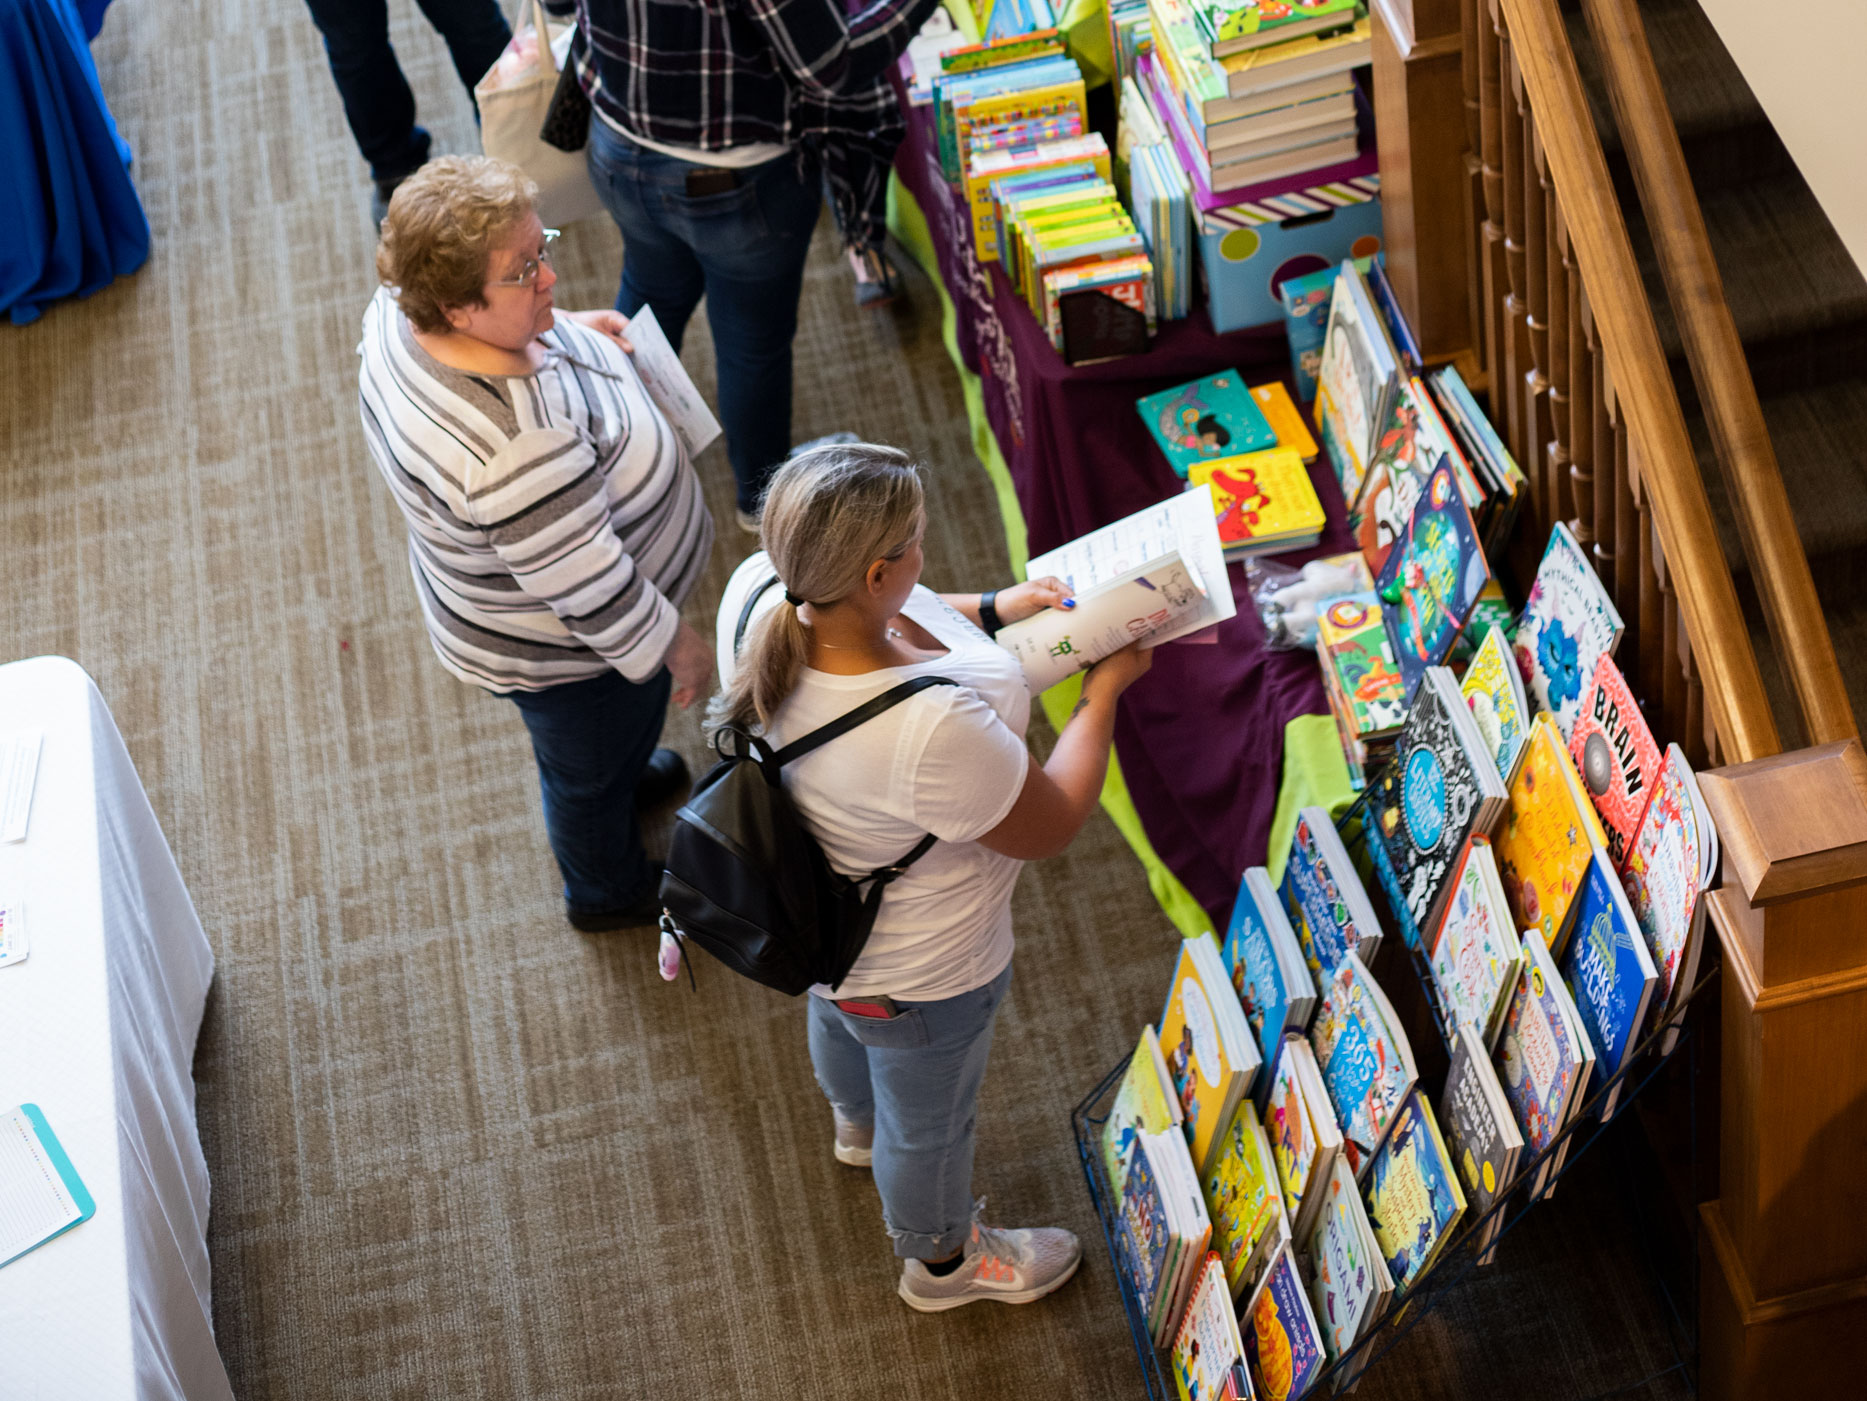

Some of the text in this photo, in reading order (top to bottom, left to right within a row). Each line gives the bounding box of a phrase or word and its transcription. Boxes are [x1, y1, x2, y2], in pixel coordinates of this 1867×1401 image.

[1594, 684, 1643, 796] BRAIN
[1575, 937, 1616, 1052] BUILDINGS
[1587, 944, 1616, 1005] MAKE
[1345, 1025, 1374, 1081] 365
[1457, 1077, 1490, 1155] ACADEMY
[1464, 1056, 1496, 1143] ENGINEER
[1396, 1162, 1418, 1222] Mystery
[1326, 1202, 1356, 1321] ORIGAMI
